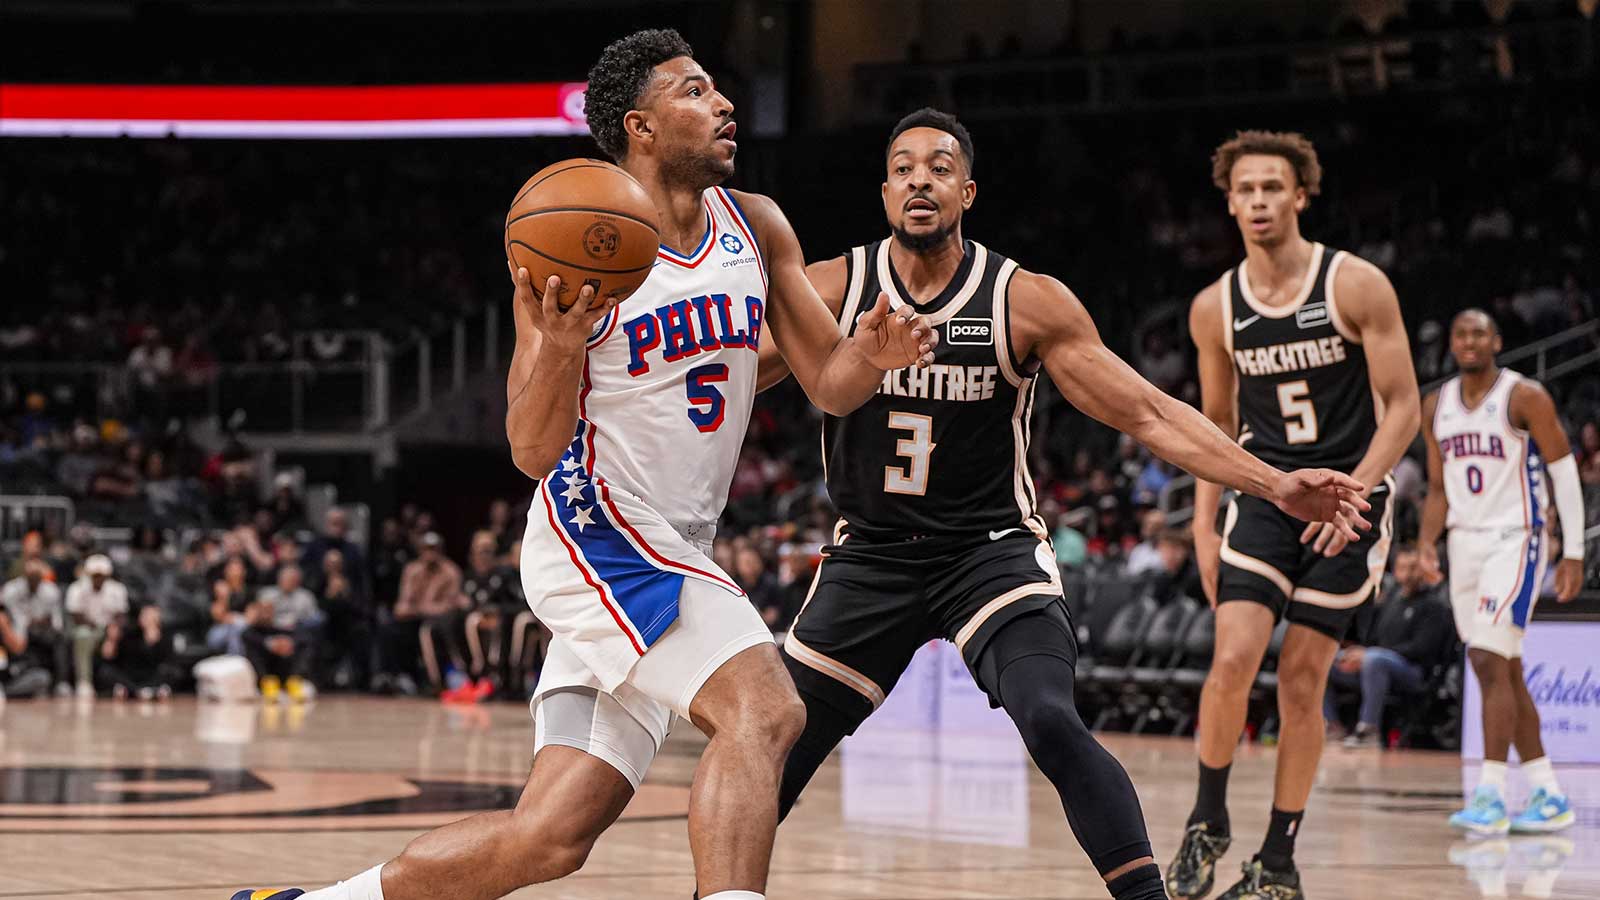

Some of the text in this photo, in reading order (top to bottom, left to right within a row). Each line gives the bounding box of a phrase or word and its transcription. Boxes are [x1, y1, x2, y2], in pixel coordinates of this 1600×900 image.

[721, 257, 757, 269] crypto.com
[623, 293, 764, 377] PHILA
[951, 324, 989, 337] paze
[686, 363, 729, 433] 5
[876, 363, 998, 401] ACHTREE
[1277, 380, 1318, 444] 5
[884, 411, 937, 496] 3
[1441, 432, 1506, 461] PHILA
[1467, 465, 1483, 494] 0
